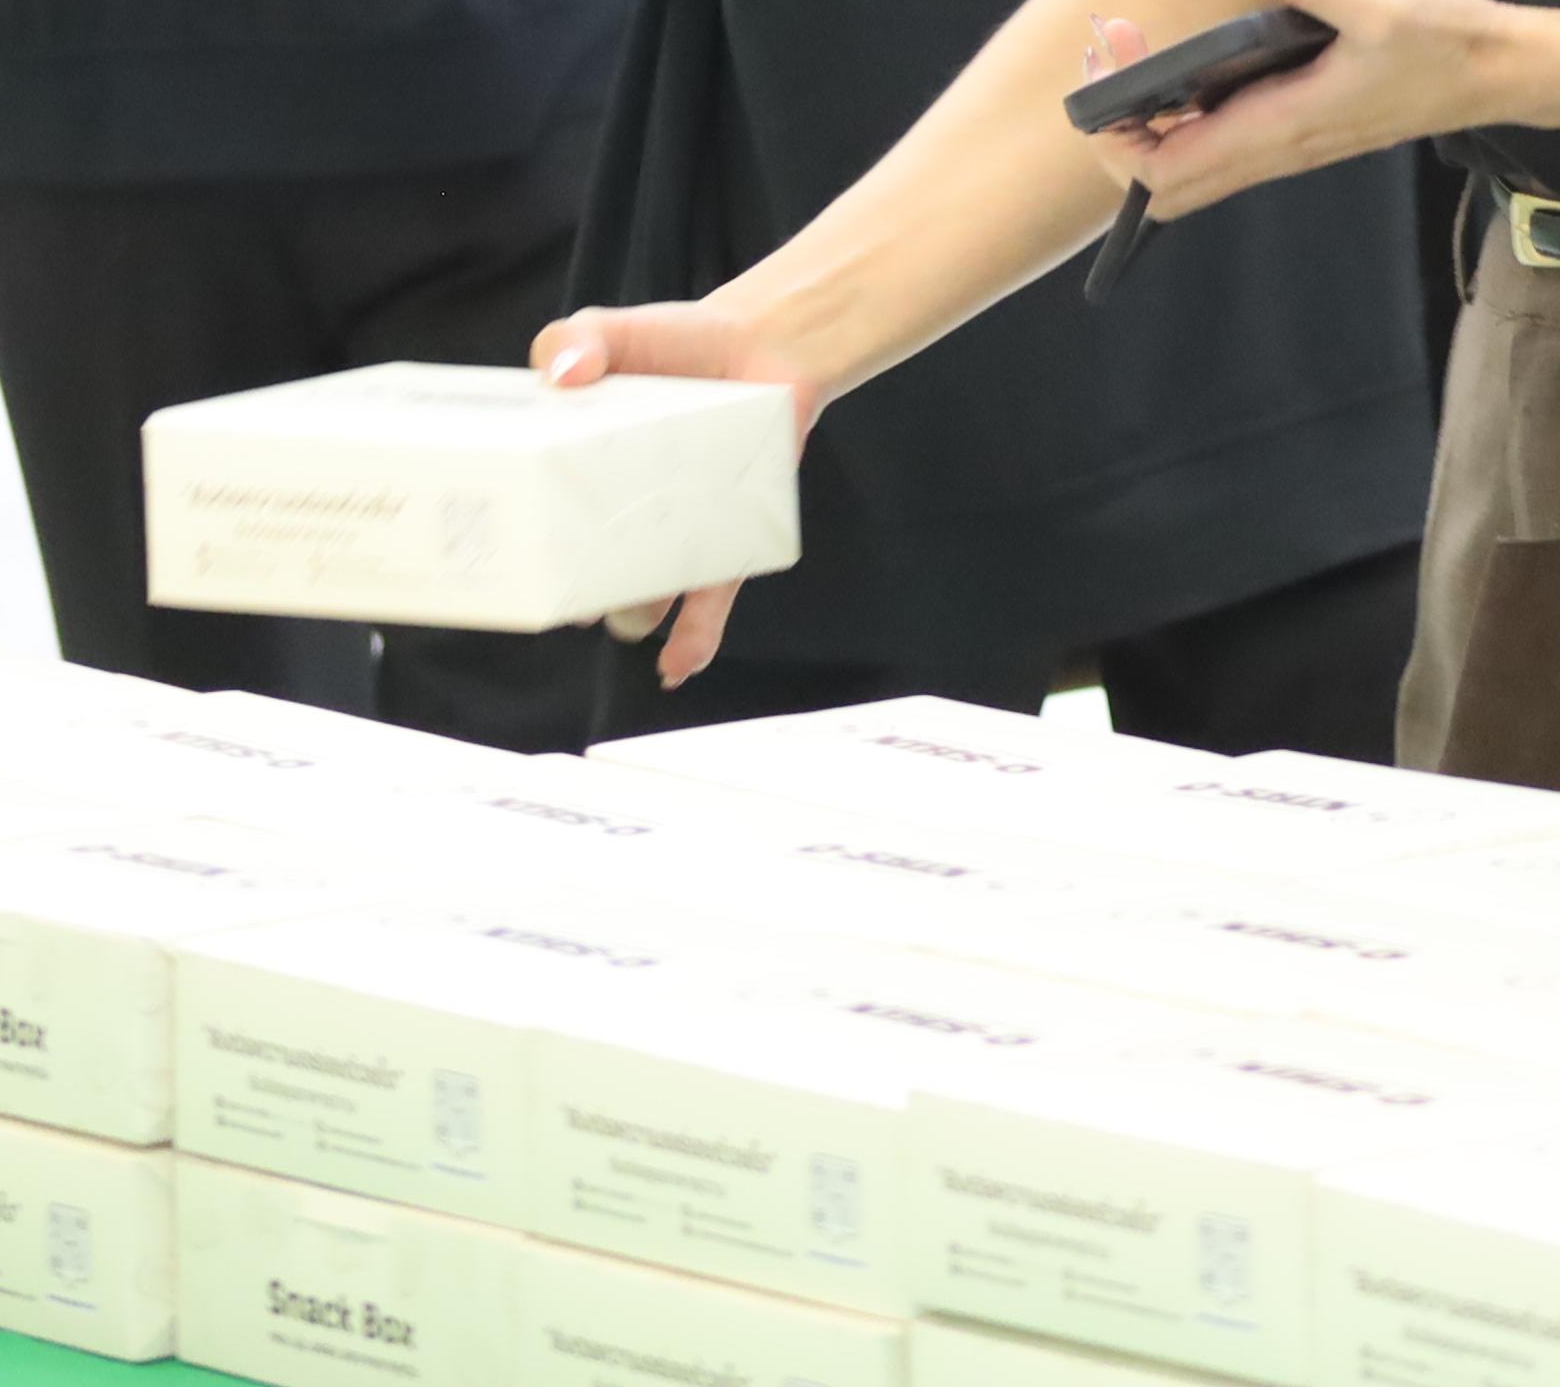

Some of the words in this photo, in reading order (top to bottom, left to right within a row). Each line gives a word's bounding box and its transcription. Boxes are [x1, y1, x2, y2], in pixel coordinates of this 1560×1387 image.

[0, 1007, 48, 1052] Box
[269, 1280, 353, 1331] Snack
[363, 1300, 416, 1349] Box
